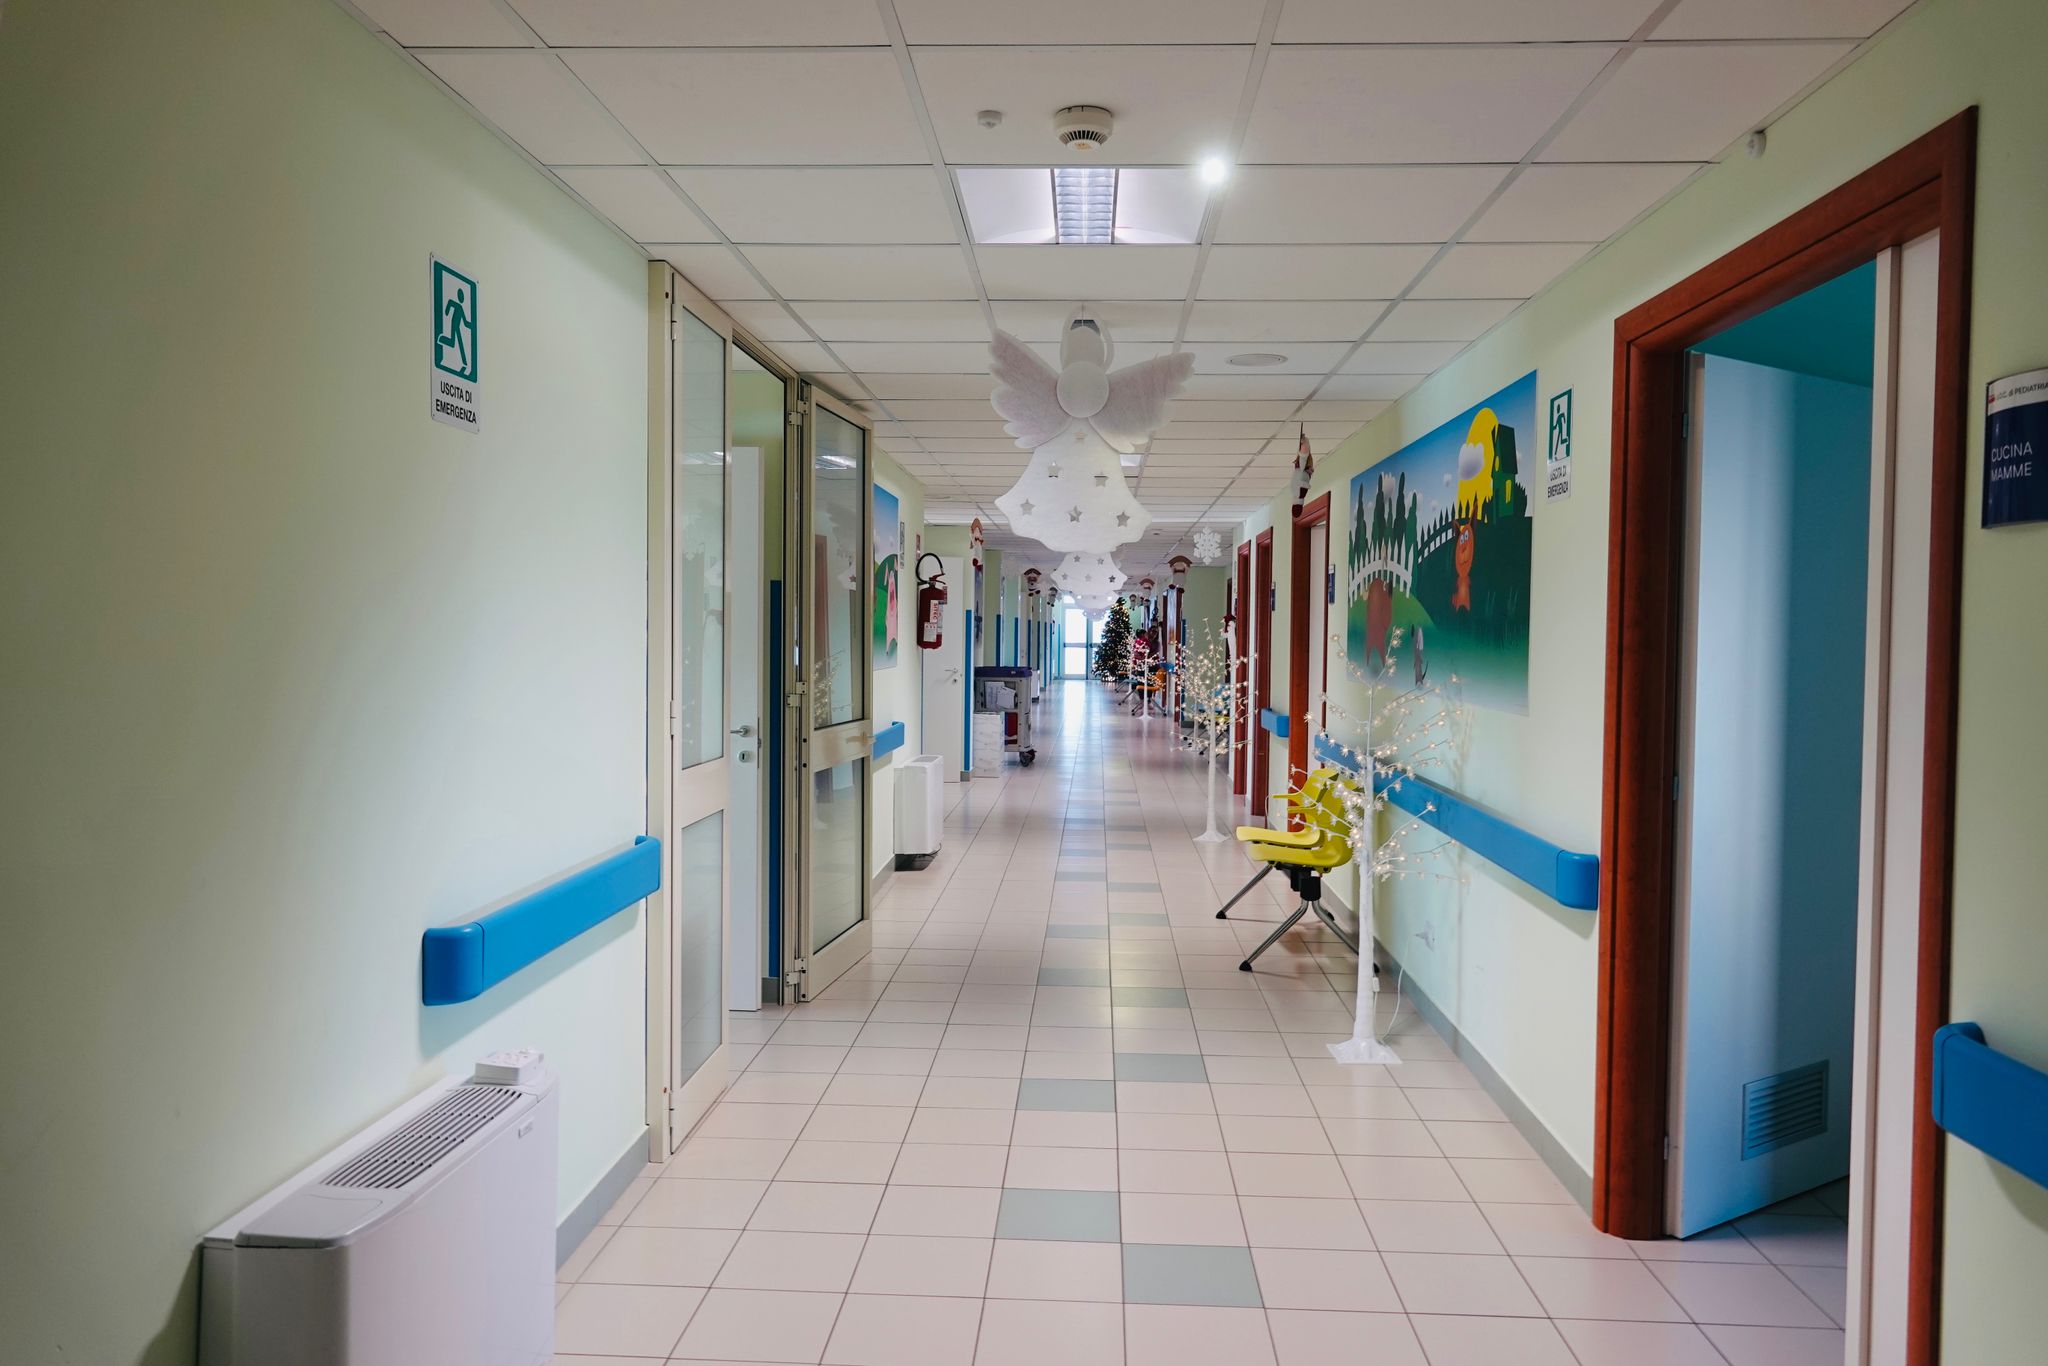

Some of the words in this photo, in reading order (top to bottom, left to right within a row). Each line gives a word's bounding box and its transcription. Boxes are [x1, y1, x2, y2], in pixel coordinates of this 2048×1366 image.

[440, 380, 464, 401] USCITA
[465, 389, 473, 404] DI
[435, 398, 477, 424] EMERGENZA
[1991, 441, 2033, 462] CUCINA
[1991, 461, 2032, 481] MAMME
